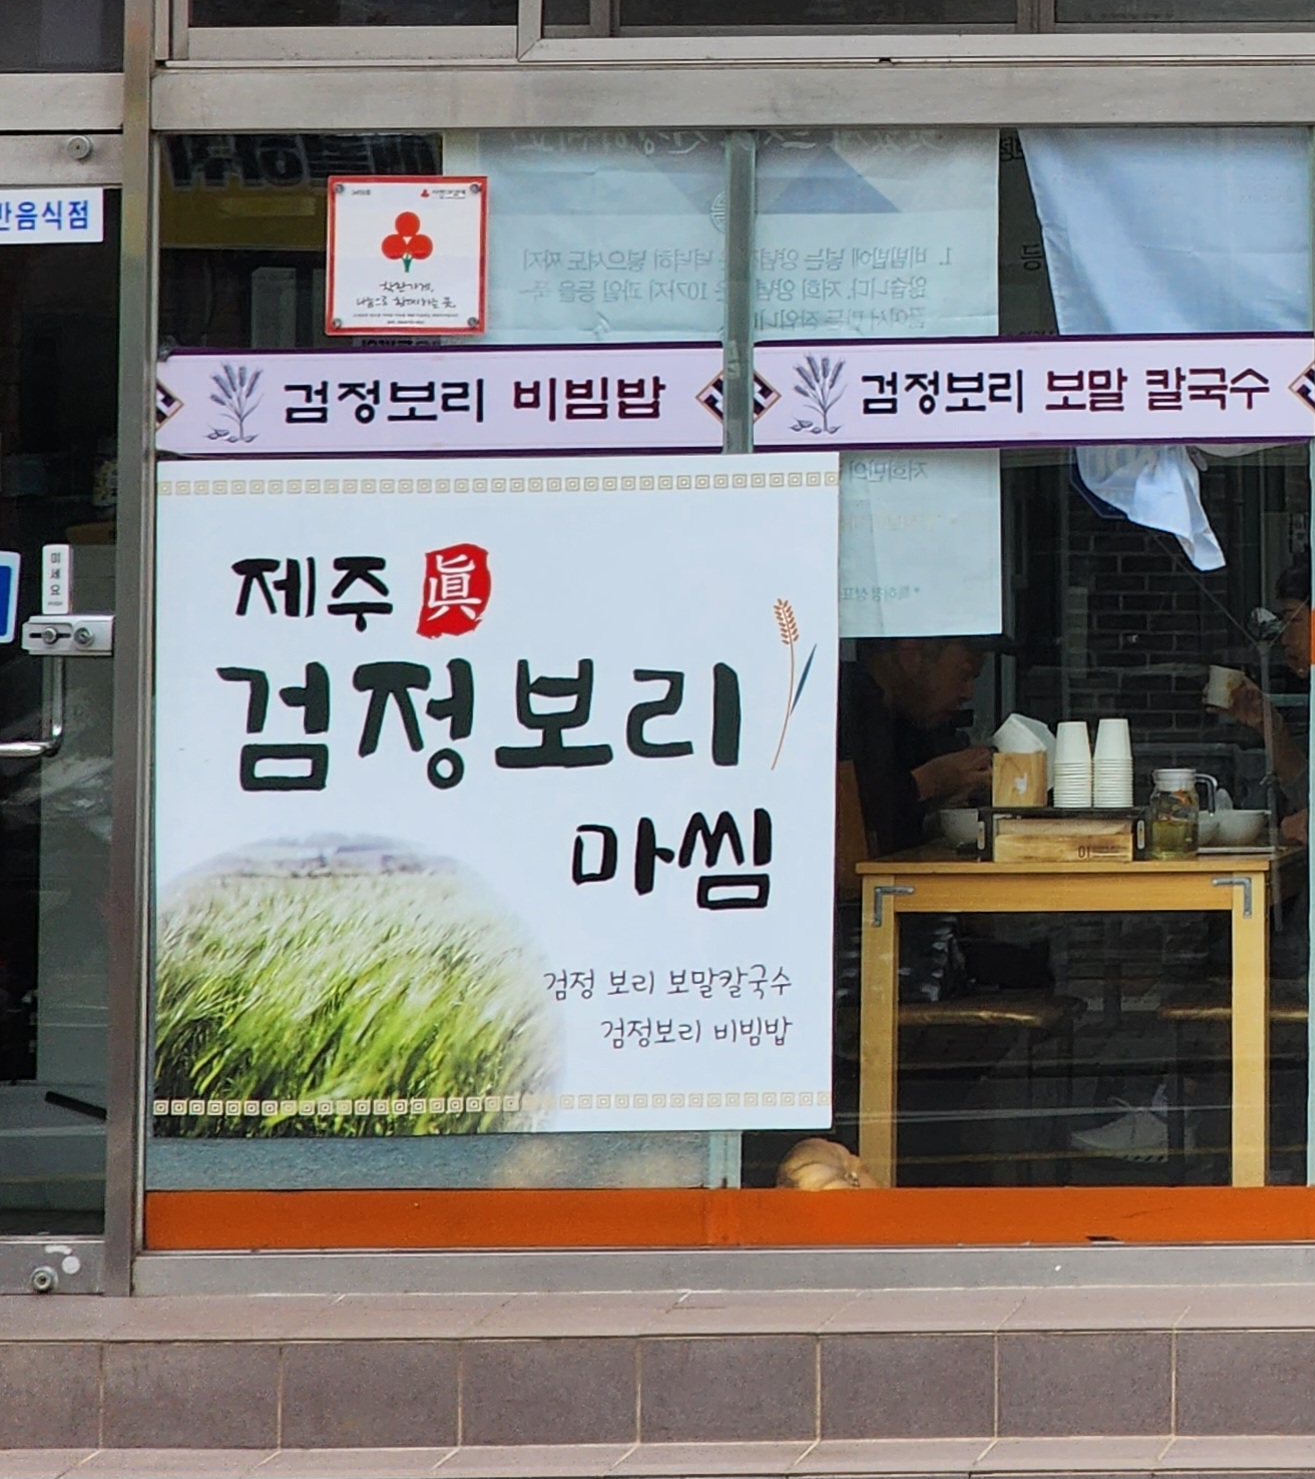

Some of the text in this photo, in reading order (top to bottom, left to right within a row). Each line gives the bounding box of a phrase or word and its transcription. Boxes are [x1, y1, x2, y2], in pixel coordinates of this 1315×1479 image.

[284, 374, 665, 425] 검정보리 비빔밥
[861, 365, 1270, 415] 검정보리 보말 칼국수
[232, 556, 393, 632] 제주
[217, 658, 742, 791] 검정보리
[571, 808, 772, 910] 마씸
[545, 964, 792, 1002] 검정 보리 보말칼국수
[600, 1015, 791, 1050] 검정보리 비빔밥
